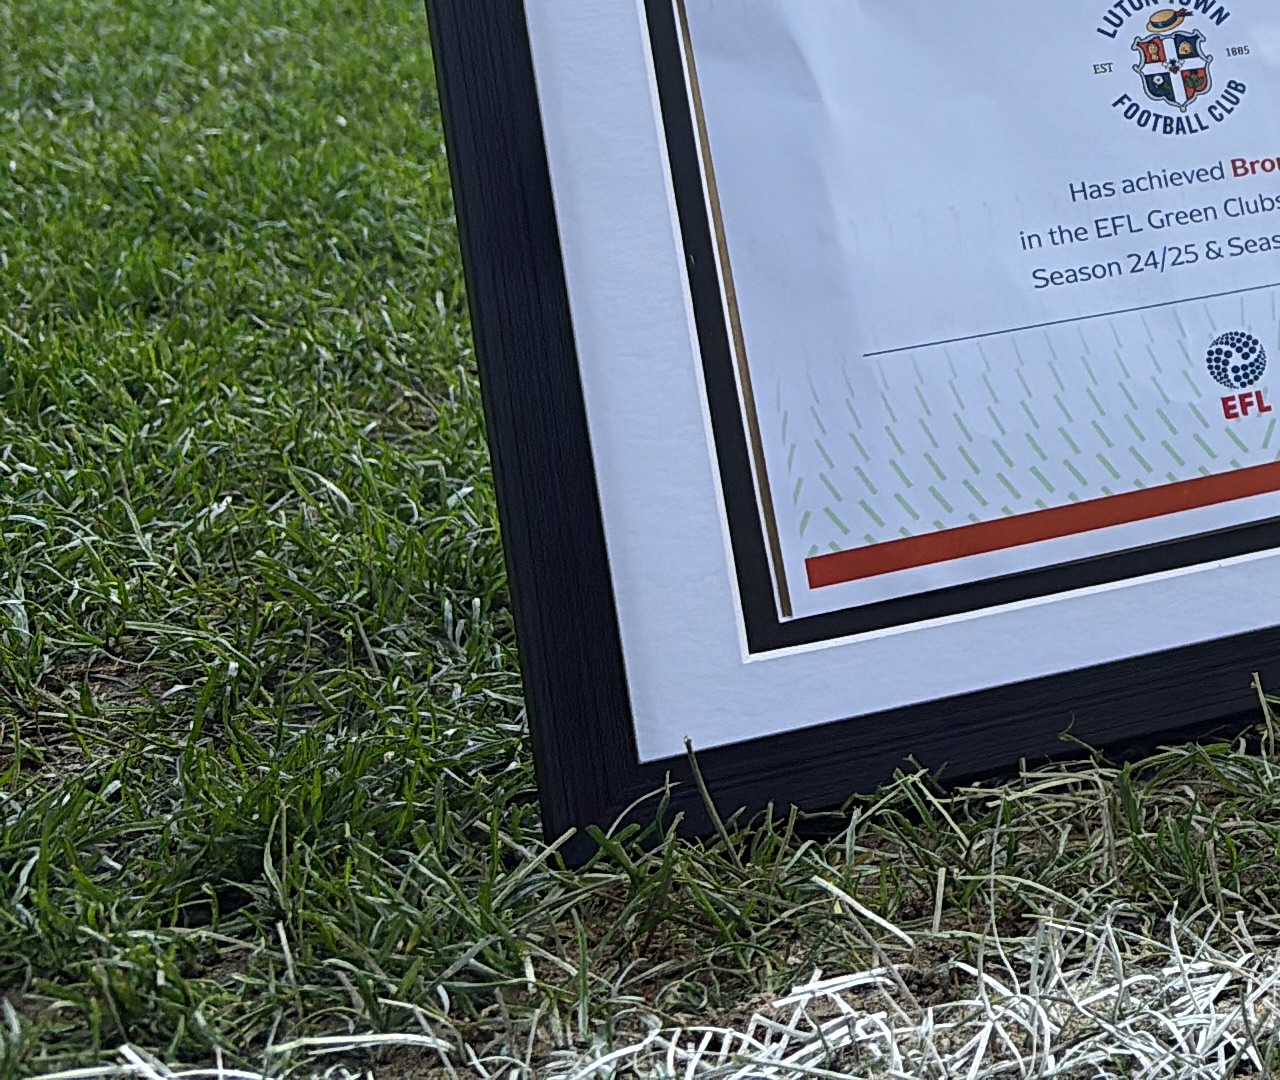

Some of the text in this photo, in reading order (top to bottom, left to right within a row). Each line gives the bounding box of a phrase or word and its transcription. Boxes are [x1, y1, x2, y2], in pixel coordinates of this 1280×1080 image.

[1093, 63, 1113, 74] EST
[1225, 45, 1250, 57] 1885
[1111, 79, 1246, 135] FOOTBALL CLUB
[1068, 179, 1116, 202] Has
[1122, 161, 1226, 194] achieved
[1020, 230, 1042, 251] in
[1049, 224, 1089, 246] the
[1094, 214, 1144, 239] EFL
[1147, 204, 1218, 230] Green
[1032, 261, 1122, 289] Season
[1127, 243, 1199, 274] 24/25
[1205, 240, 1224, 260] &
[1220, 390, 1272, 420] EFL
